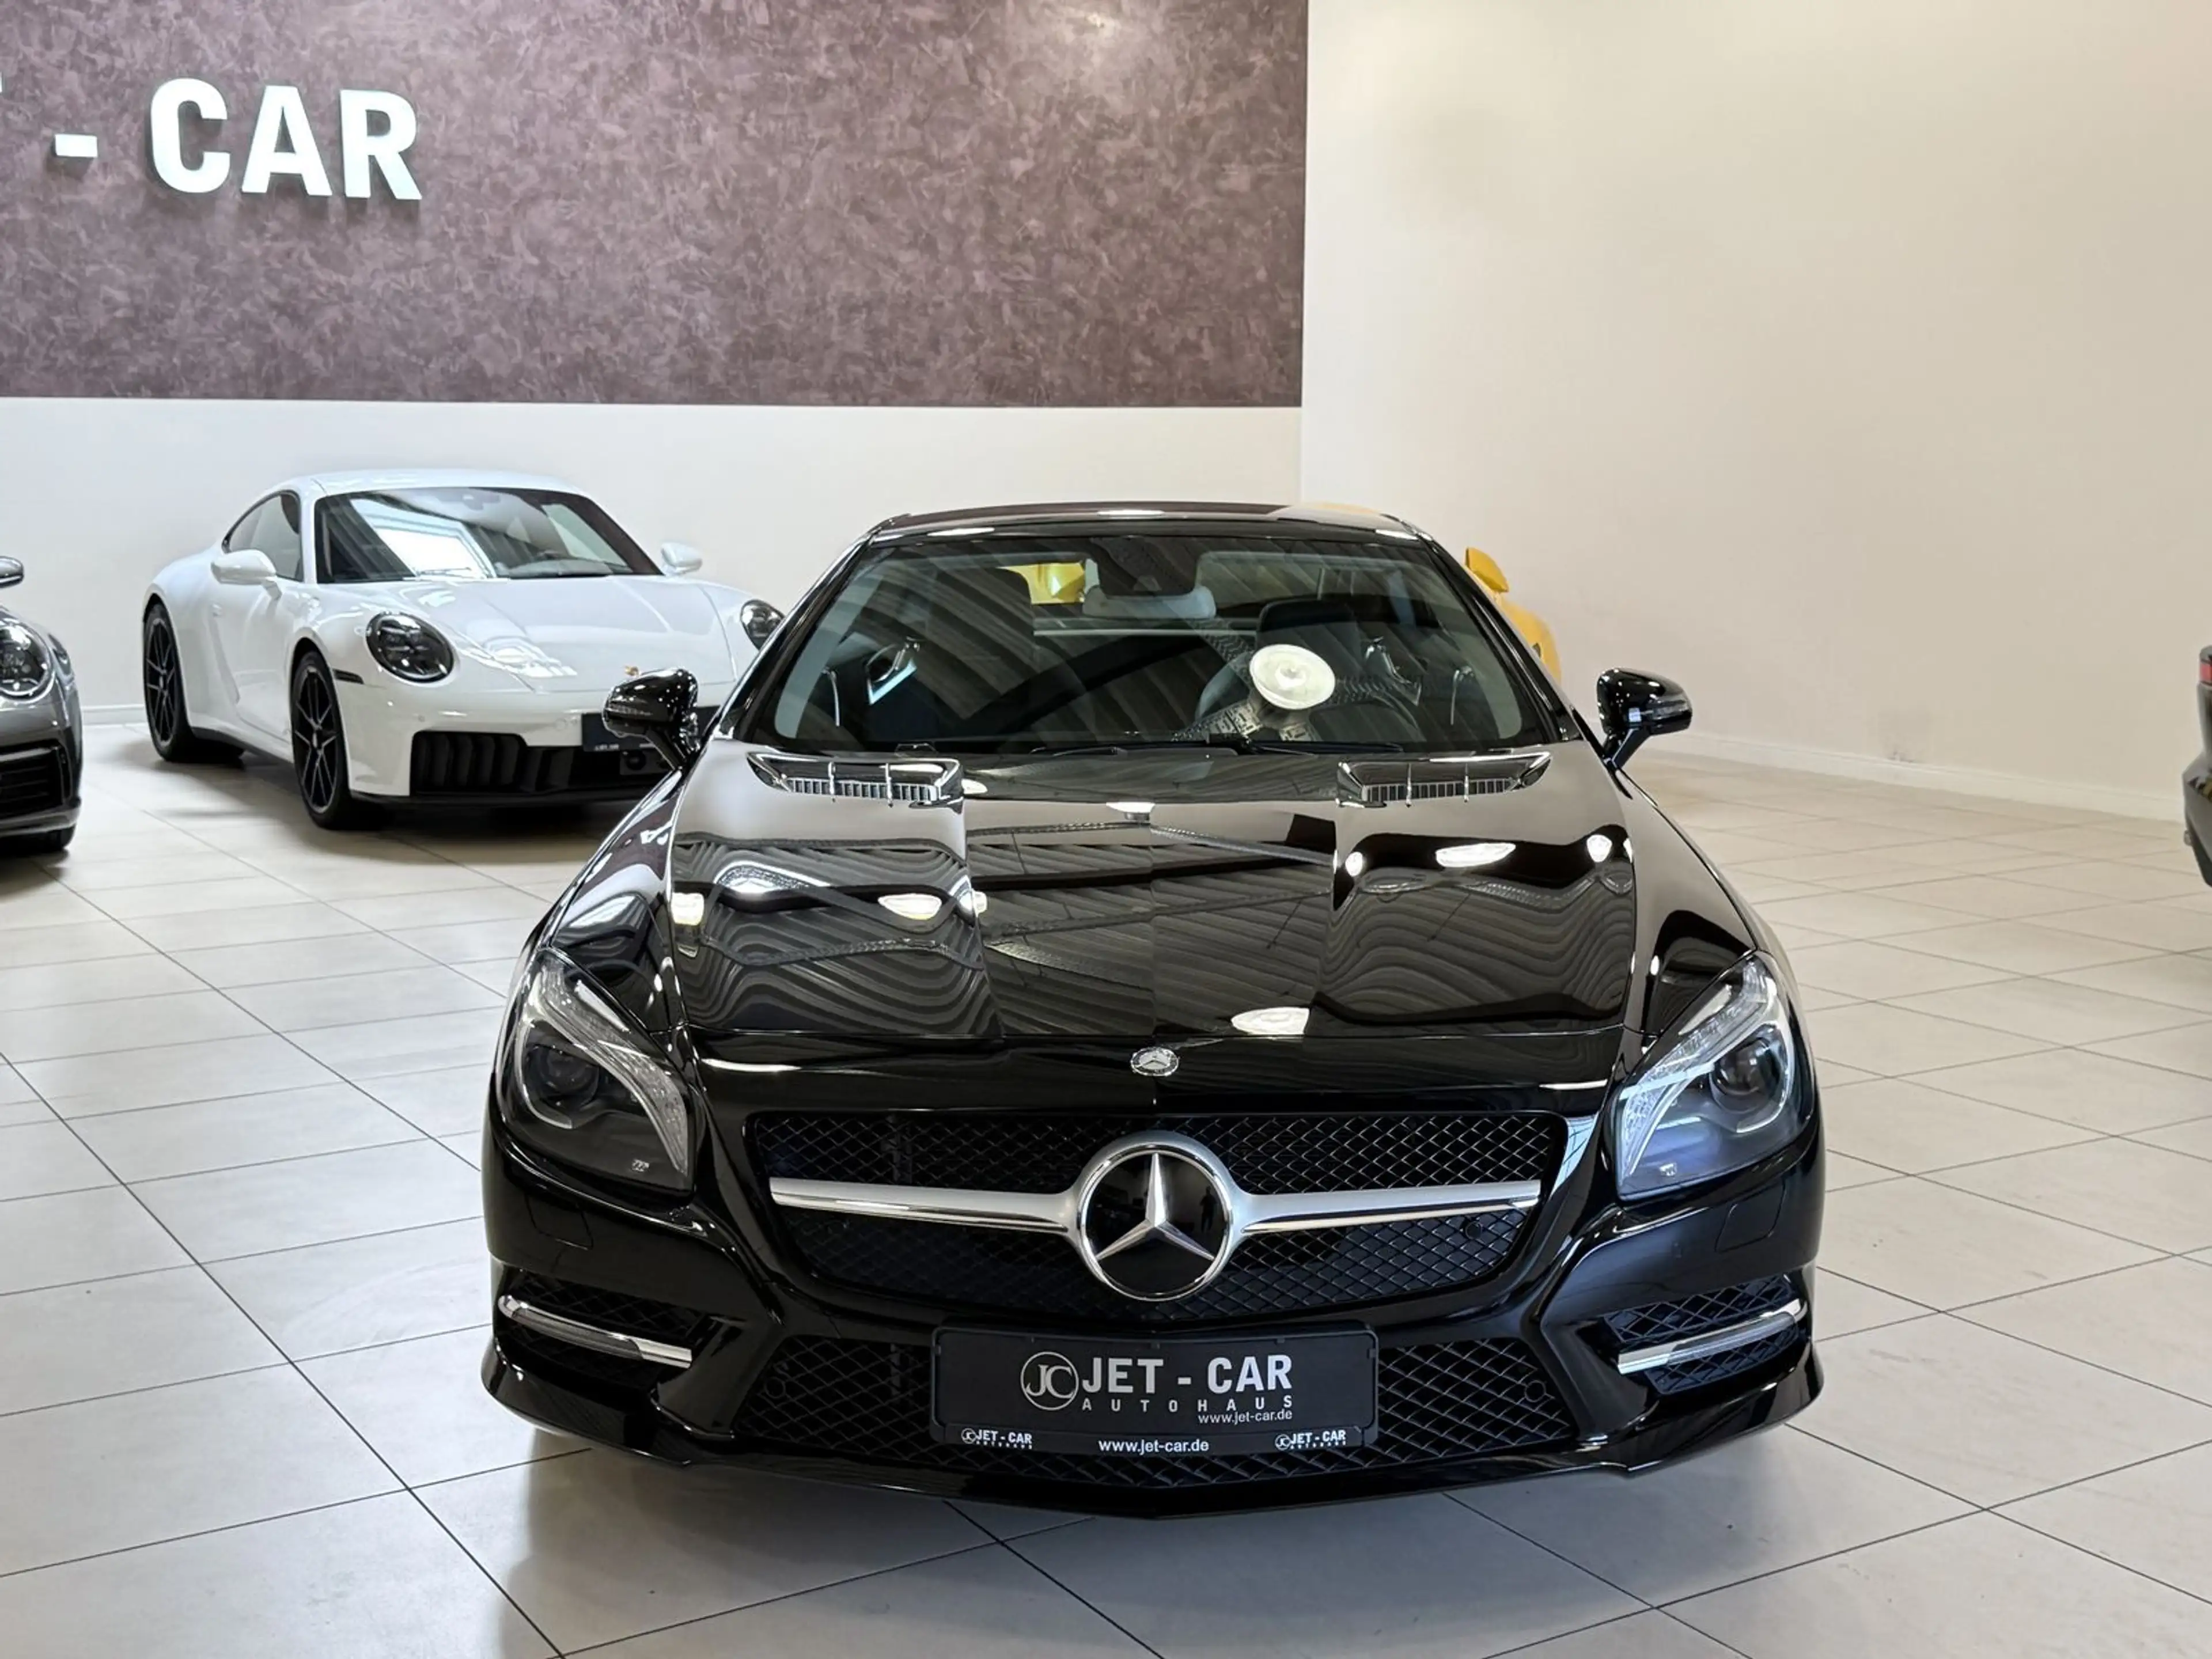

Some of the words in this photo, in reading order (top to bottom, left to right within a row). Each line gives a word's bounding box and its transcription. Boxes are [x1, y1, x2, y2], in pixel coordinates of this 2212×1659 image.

[150, 78, 423, 200] CAR
[1082, 1357, 1164, 1394] JET
[1177, 1377, 1192, 1385] -
[1207, 1354, 1293, 1395] CAR
[1082, 1395, 1293, 1412] AUTOHAUS
[1198, 1409, 1293, 1425] www.jet-car.de
[976, 1429, 998, 1441] JET
[1007, 1431, 1032, 1444] CAR
[1290, 1432, 1312, 1444] JET
[1322, 1429, 1346, 1442] CAR
[1098, 1439, 1209, 1455] www.jet-car.de
